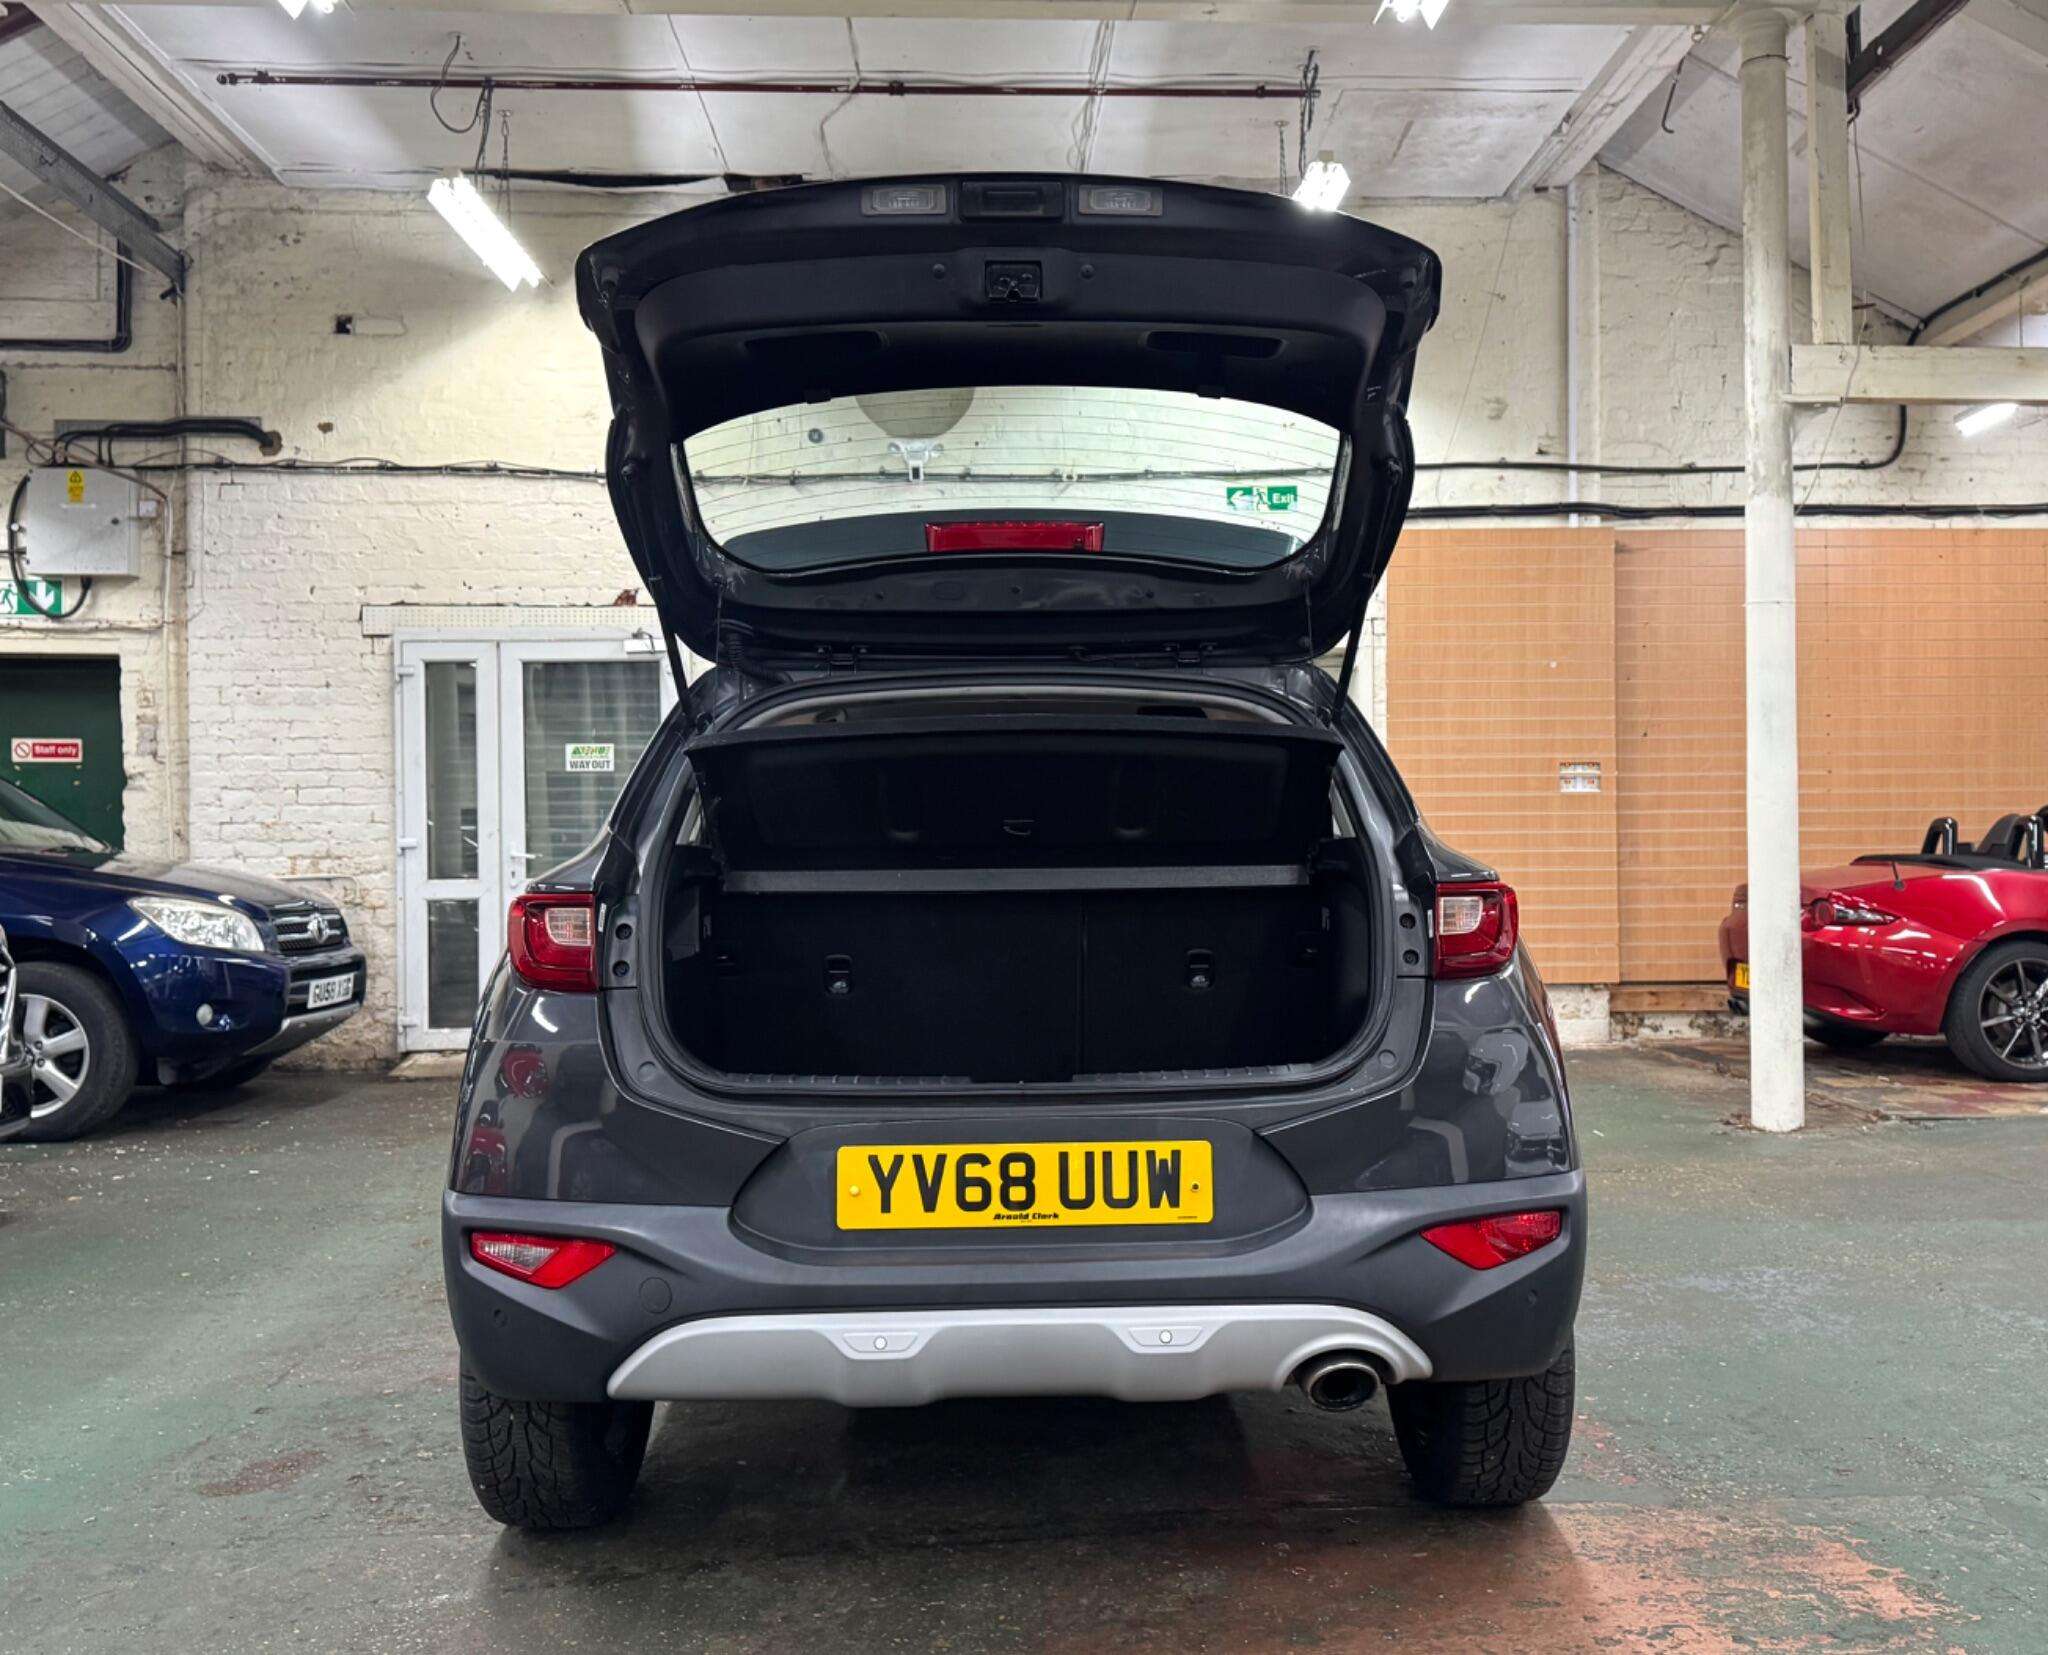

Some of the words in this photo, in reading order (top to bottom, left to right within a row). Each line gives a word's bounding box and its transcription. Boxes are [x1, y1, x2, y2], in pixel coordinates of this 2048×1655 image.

[1272, 493, 1295, 504] Exit
[34, 745, 56, 755] Staff
[57, 745, 77, 756] only
[569, 760, 590, 769] WAY
[591, 760, 611, 769] OUT
[868, 1152, 1036, 1213] YV68
[1058, 1150, 1181, 1210] UUW
[993, 1212, 1029, 1220] Arnold
[1032, 1212, 1059, 1220] Clark
